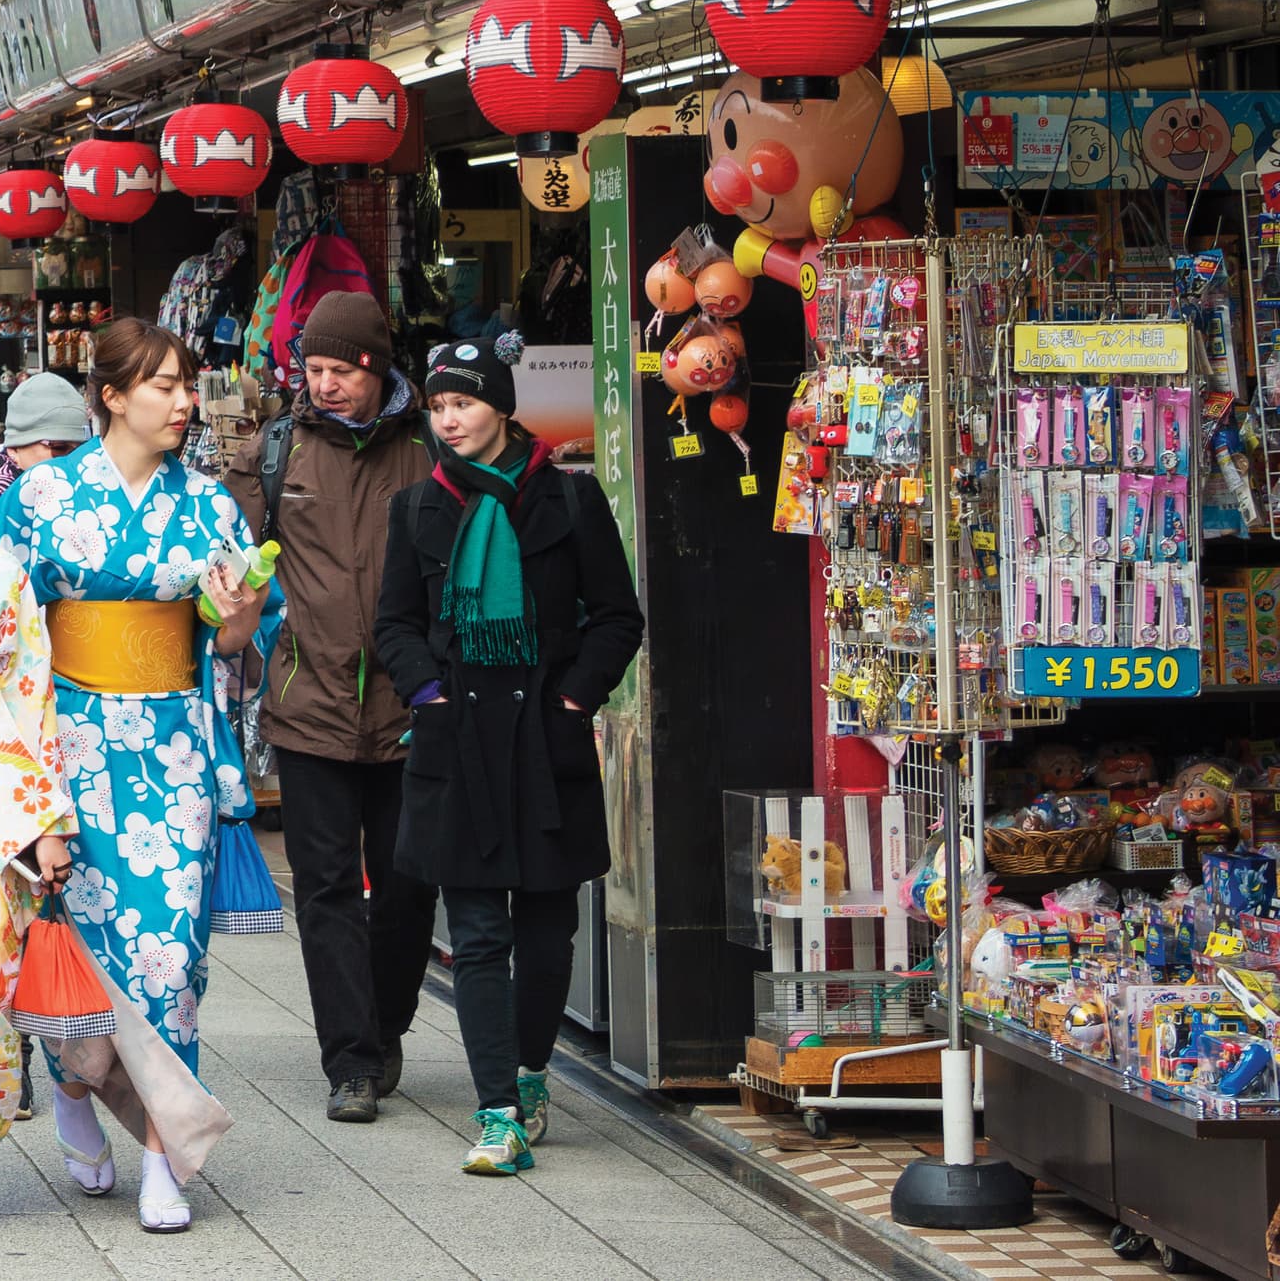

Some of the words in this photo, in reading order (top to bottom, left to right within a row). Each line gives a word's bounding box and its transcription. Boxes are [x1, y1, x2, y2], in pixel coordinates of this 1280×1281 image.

[528, 361, 594, 370] 東京みやげの
[1019, 350, 1075, 368] Japan
[1083, 349, 1178, 367] Movement
